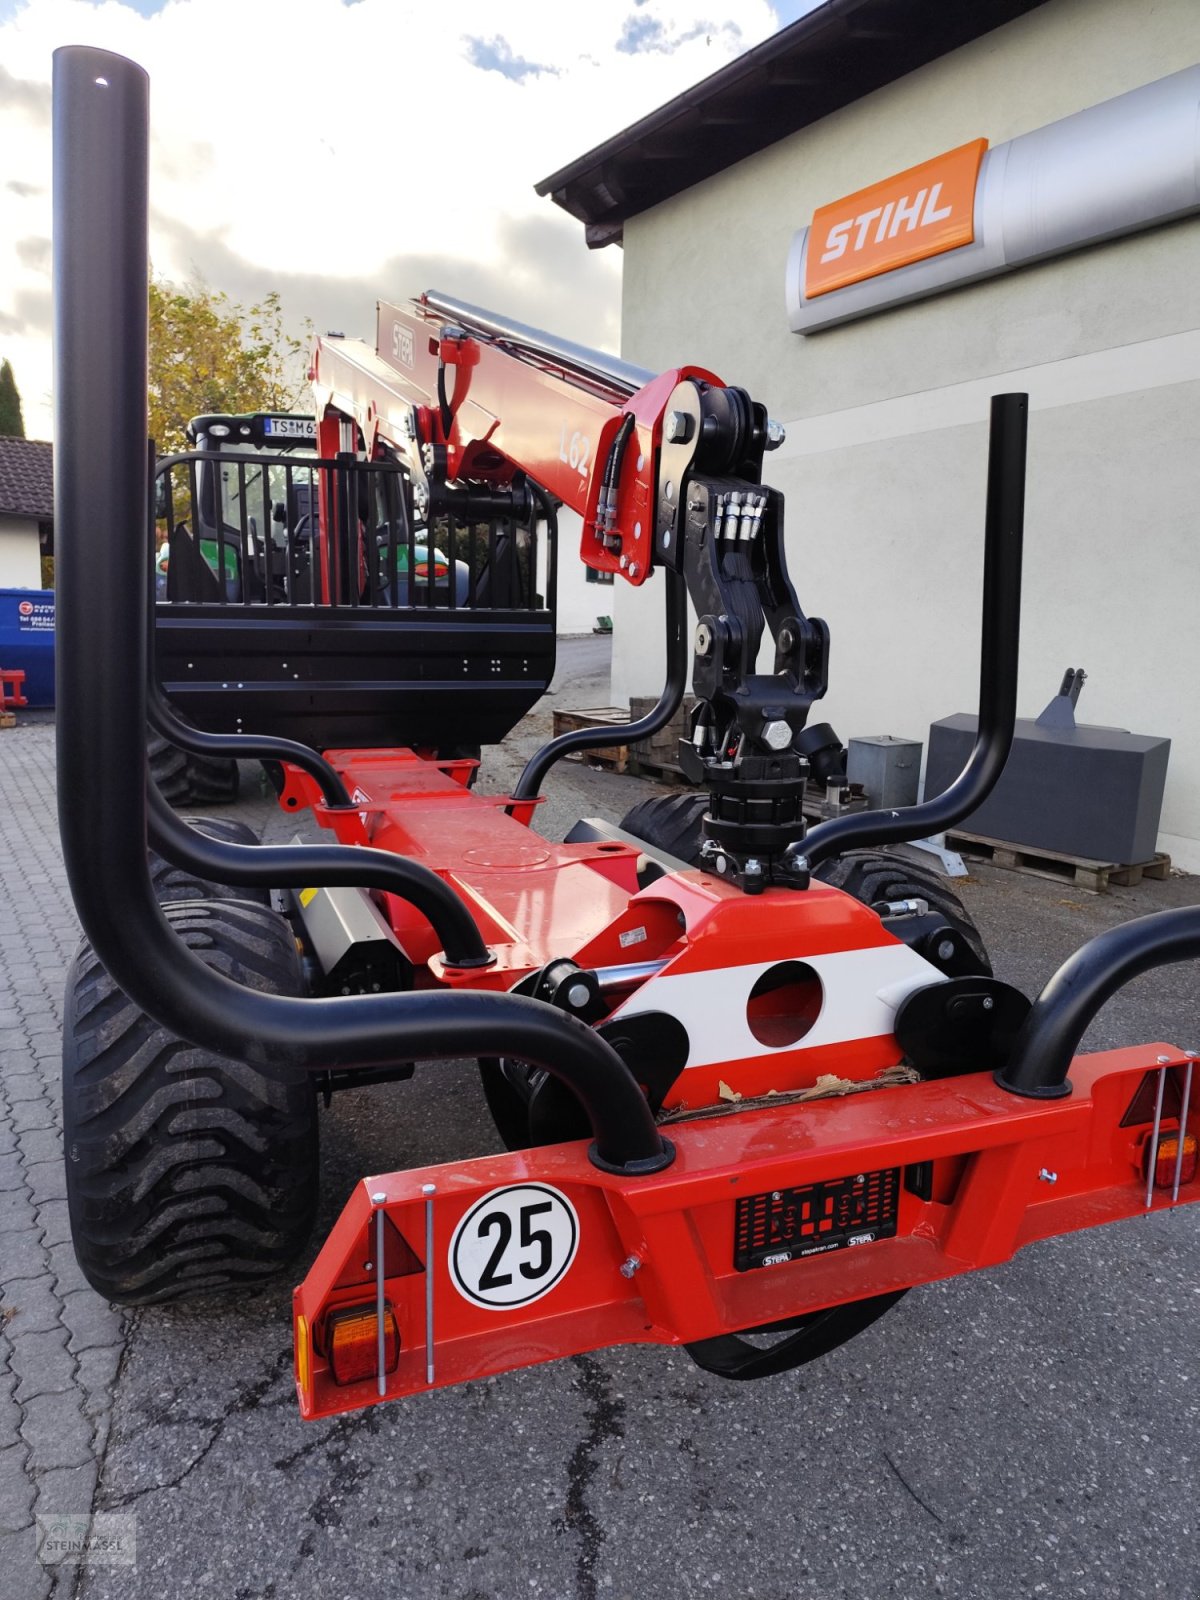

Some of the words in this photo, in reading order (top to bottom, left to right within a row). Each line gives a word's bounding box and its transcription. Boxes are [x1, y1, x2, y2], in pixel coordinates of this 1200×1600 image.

[820, 182, 952, 264] STIHL
[392, 323, 413, 367] STEPA
[272, 420, 288, 433] TS
[296, 421, 304, 433] M
[559, 420, 590, 478] L62
[477, 1201, 552, 1291] 25
[763, 1252, 791, 1267] STEPA
[801, 1243, 838, 1255] stepakran.com
[847, 1232, 876, 1246] STEPA
